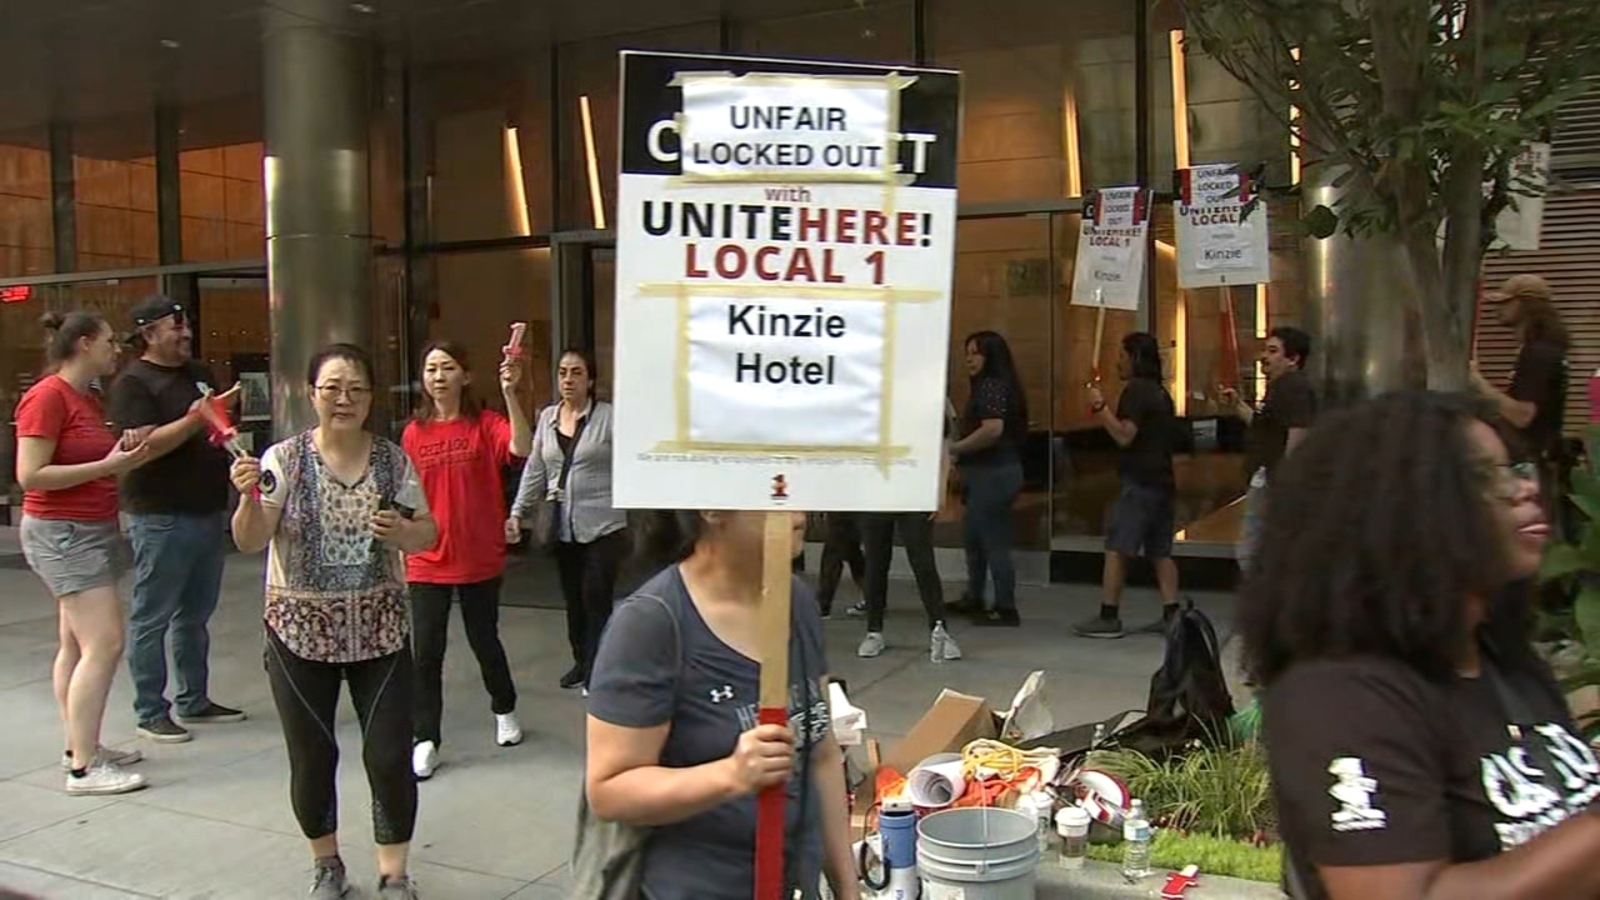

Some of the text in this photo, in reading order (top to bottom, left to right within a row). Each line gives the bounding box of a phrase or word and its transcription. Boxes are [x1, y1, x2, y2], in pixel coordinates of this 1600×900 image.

[730, 106, 847, 131] UNFAIR
[694, 142, 814, 166] LOCKED
[823, 144, 882, 168] OUT
[765, 186, 811, 202] with
[643, 200, 932, 247] UNITEHERE!
[1191, 213, 1237, 226] LOCAL
[1090, 237, 1120, 247] LOCAL
[1204, 248, 1242, 260] Kinzie
[685, 243, 886, 284] LOCAL 1
[728, 304, 847, 338] Kinzie
[735, 353, 835, 385] Hotel
